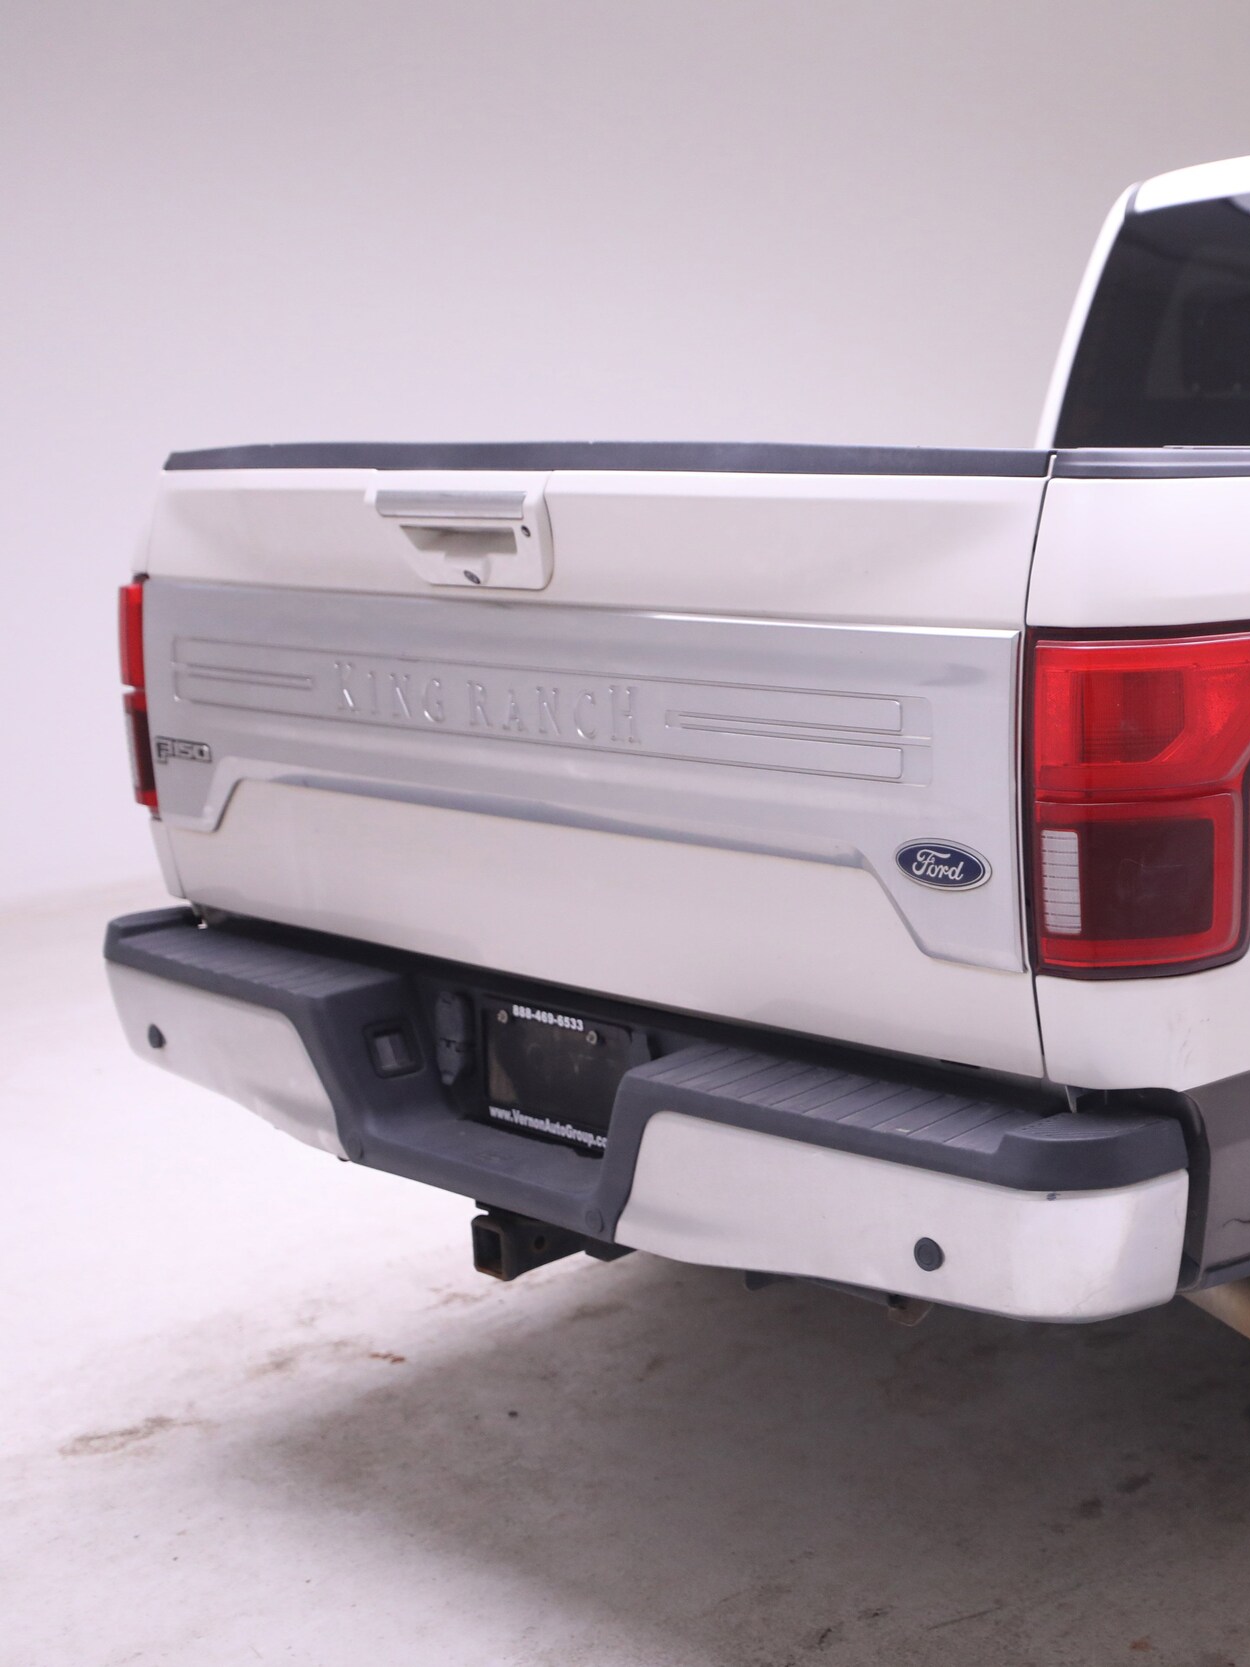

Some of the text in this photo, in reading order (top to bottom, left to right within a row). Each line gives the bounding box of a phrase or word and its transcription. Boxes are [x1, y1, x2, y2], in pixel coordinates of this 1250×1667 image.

[334, 662, 642, 744] KING RANCH
[912, 848, 965, 881] Ford
[512, 1004, 584, 1032] 888-469-6533
[488, 1105, 608, 1149] www.VernonAutoGroup.co
